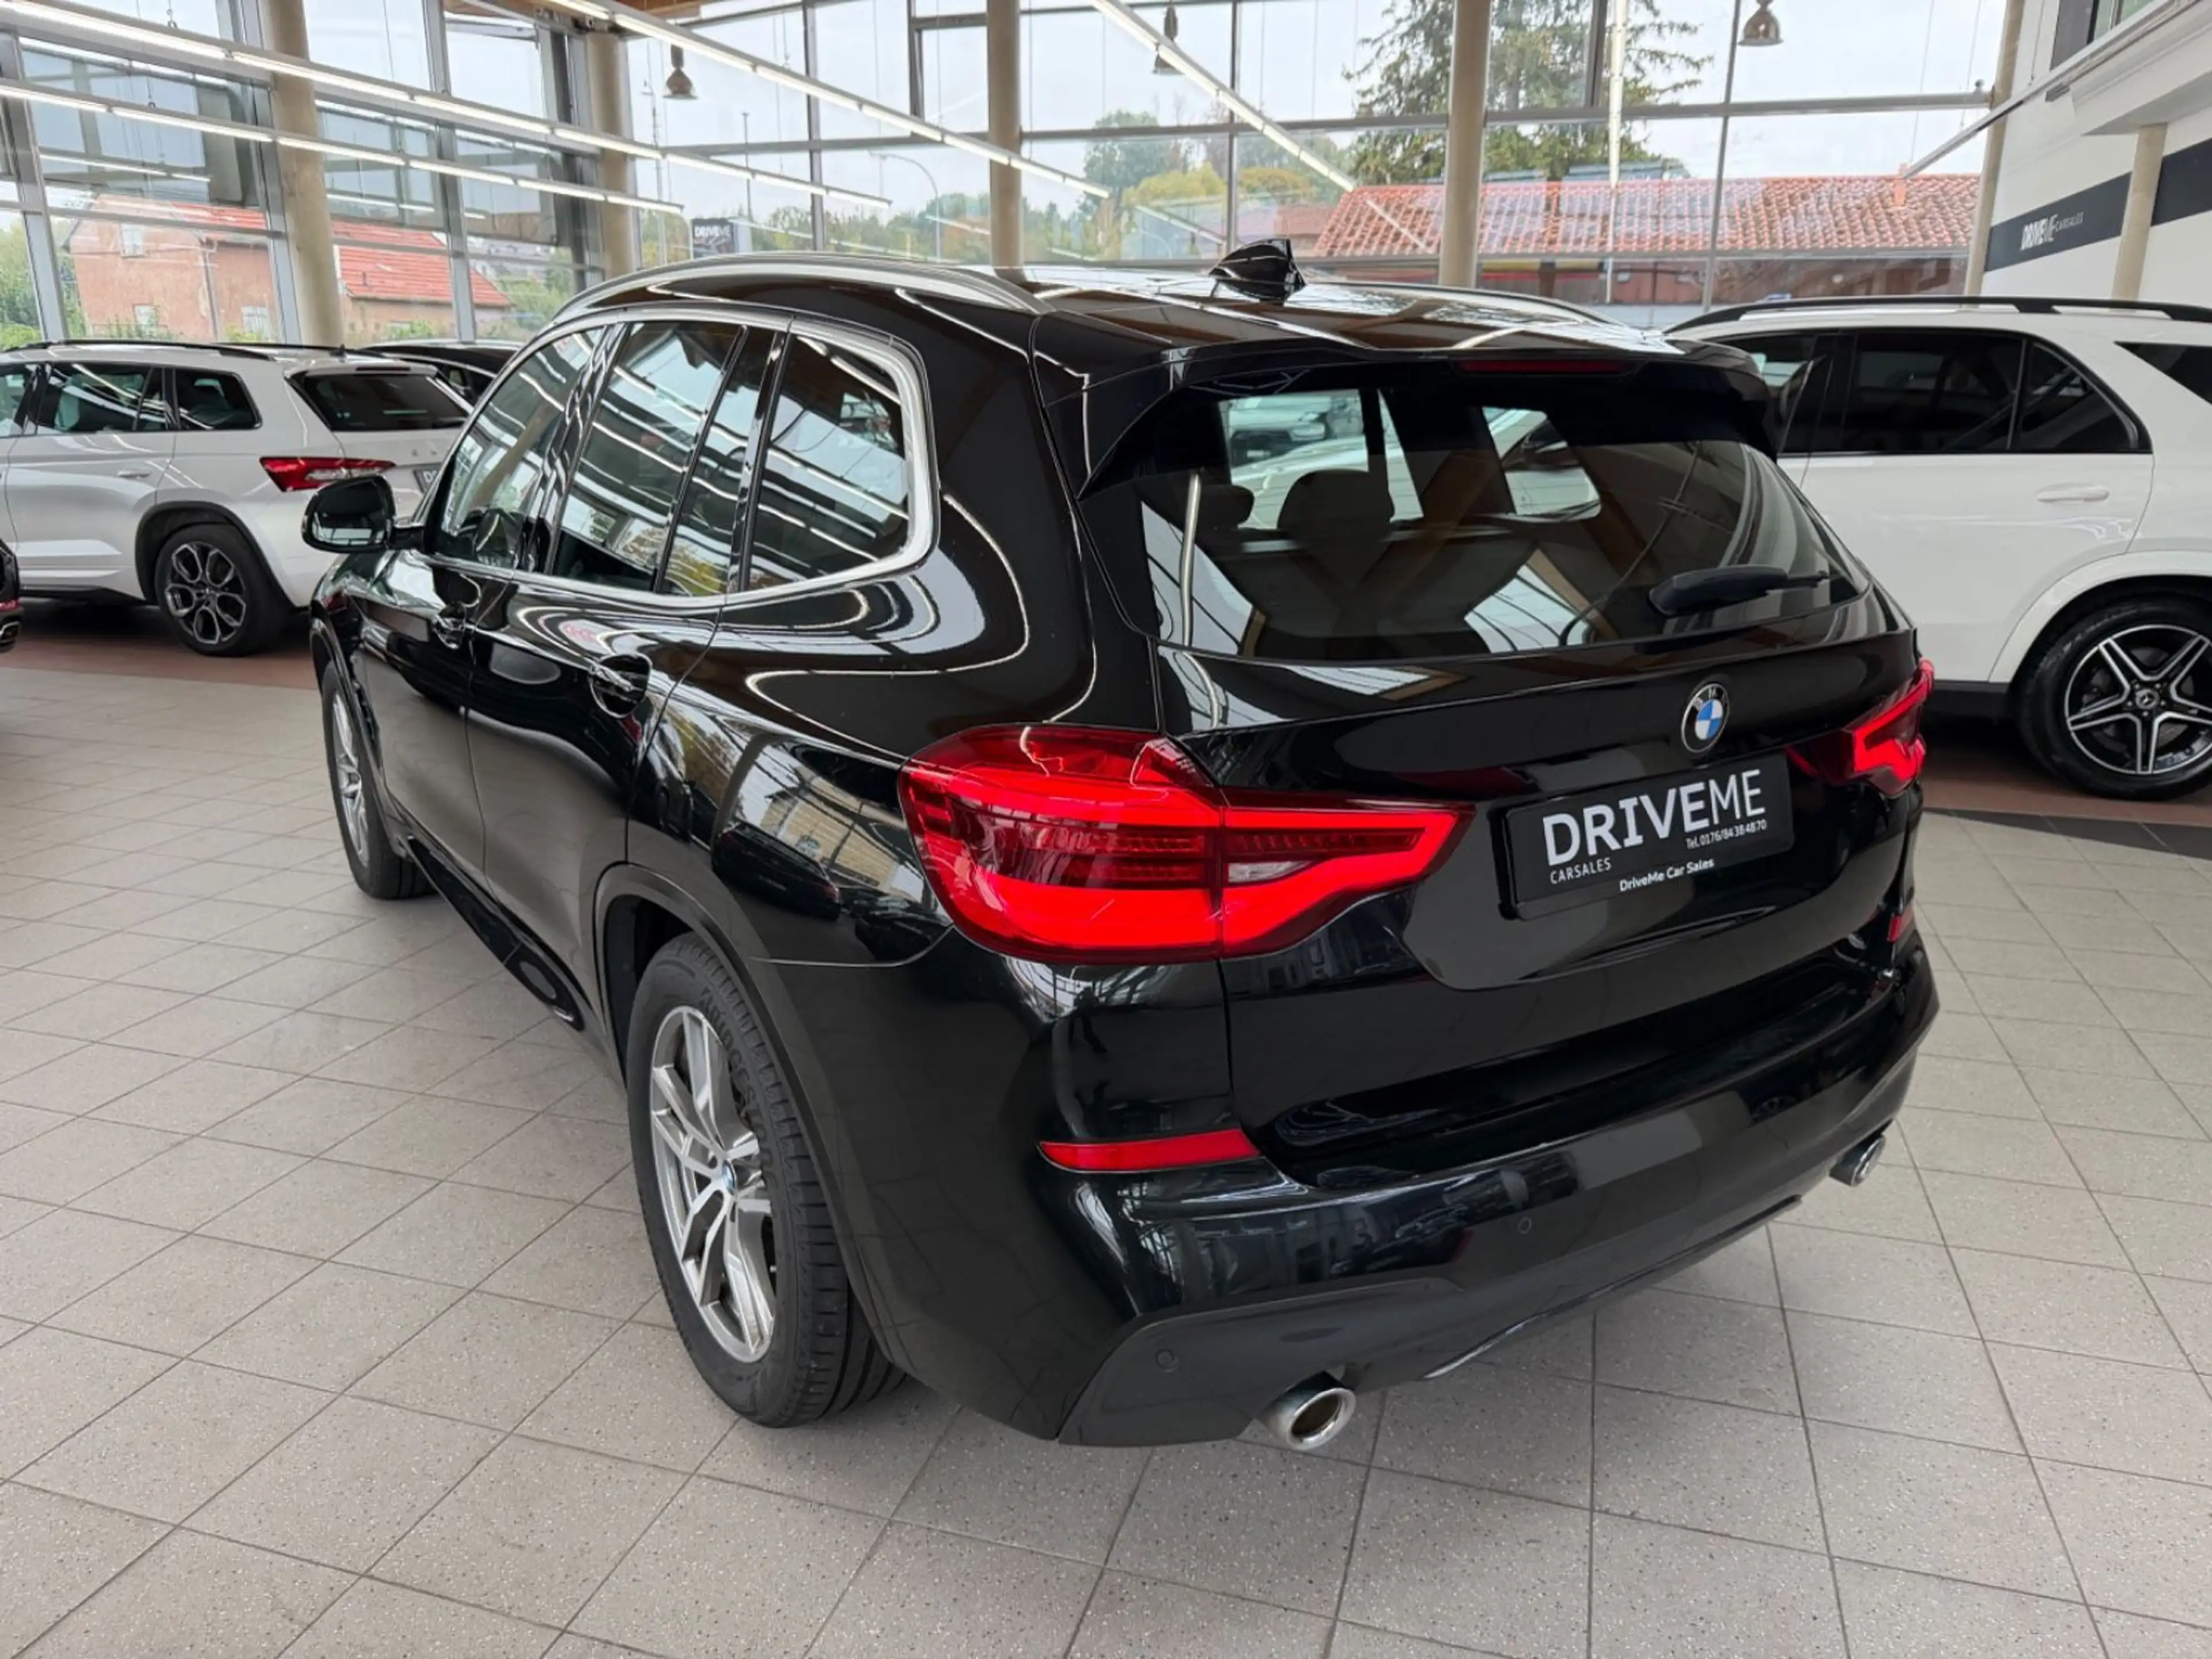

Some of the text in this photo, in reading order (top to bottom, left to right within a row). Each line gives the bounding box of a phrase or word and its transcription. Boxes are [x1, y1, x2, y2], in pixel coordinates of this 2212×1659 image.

[1543, 769, 1766, 866] DRIVEME
[1550, 857, 1612, 884] CARSALES
[1619, 858, 1714, 892] DriveMe Car Sales
